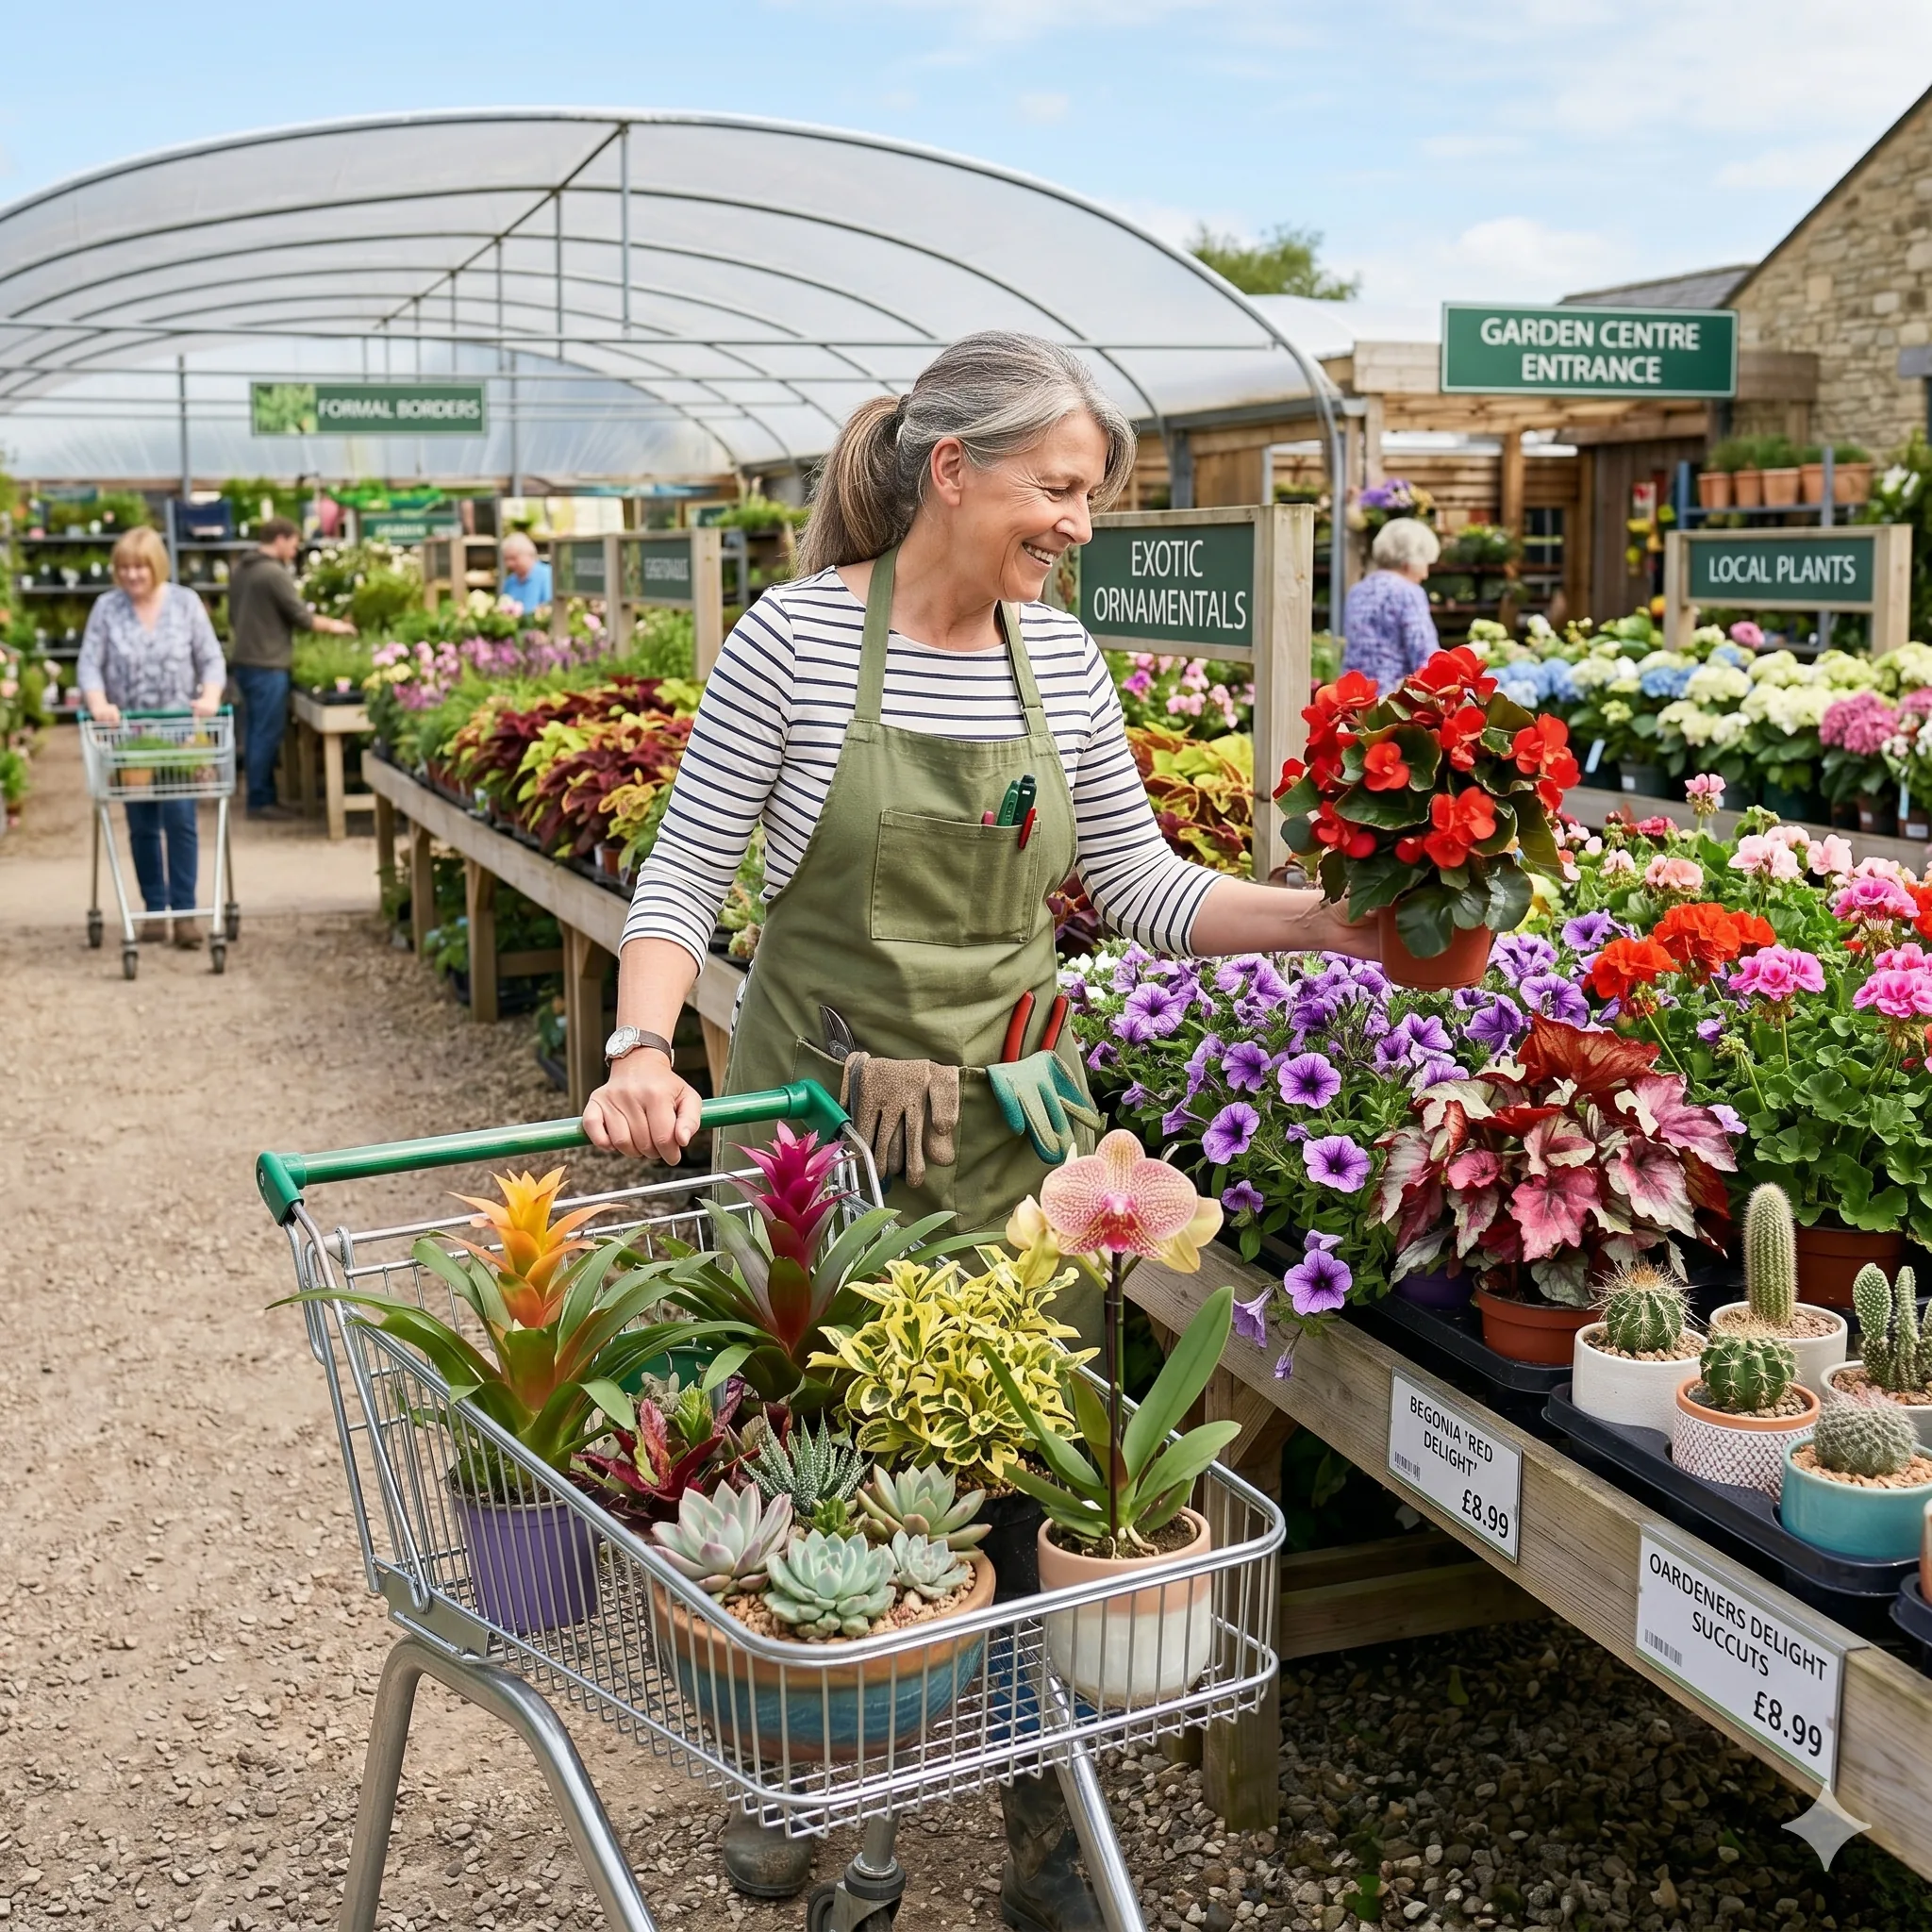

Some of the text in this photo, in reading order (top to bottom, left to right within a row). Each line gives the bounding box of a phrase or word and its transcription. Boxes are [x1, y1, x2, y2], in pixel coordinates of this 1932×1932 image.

[1480, 317, 1700, 350] GARDEN CENTRE
[1522, 354, 1661, 384] ENTRANCE
[318, 398, 481, 420] FORMAL BORDERS
[1131, 540, 1204, 578] EXOTIC
[1709, 555, 1857, 585] LOCAL PLANTS
[1093, 587, 1247, 630] ORNAMENTALS
[1410, 1395, 1493, 1463] BEGONIA 'RED
[1424, 1430, 1478, 1477] DELIGHT'
[1461, 1489, 1508, 1539] £8.99
[1649, 1553, 1828, 1681] OARDENERS DELIGHT
[1691, 1611, 1769, 1677] SUCCUTS
[1753, 1690, 1823, 1757] £8.99
